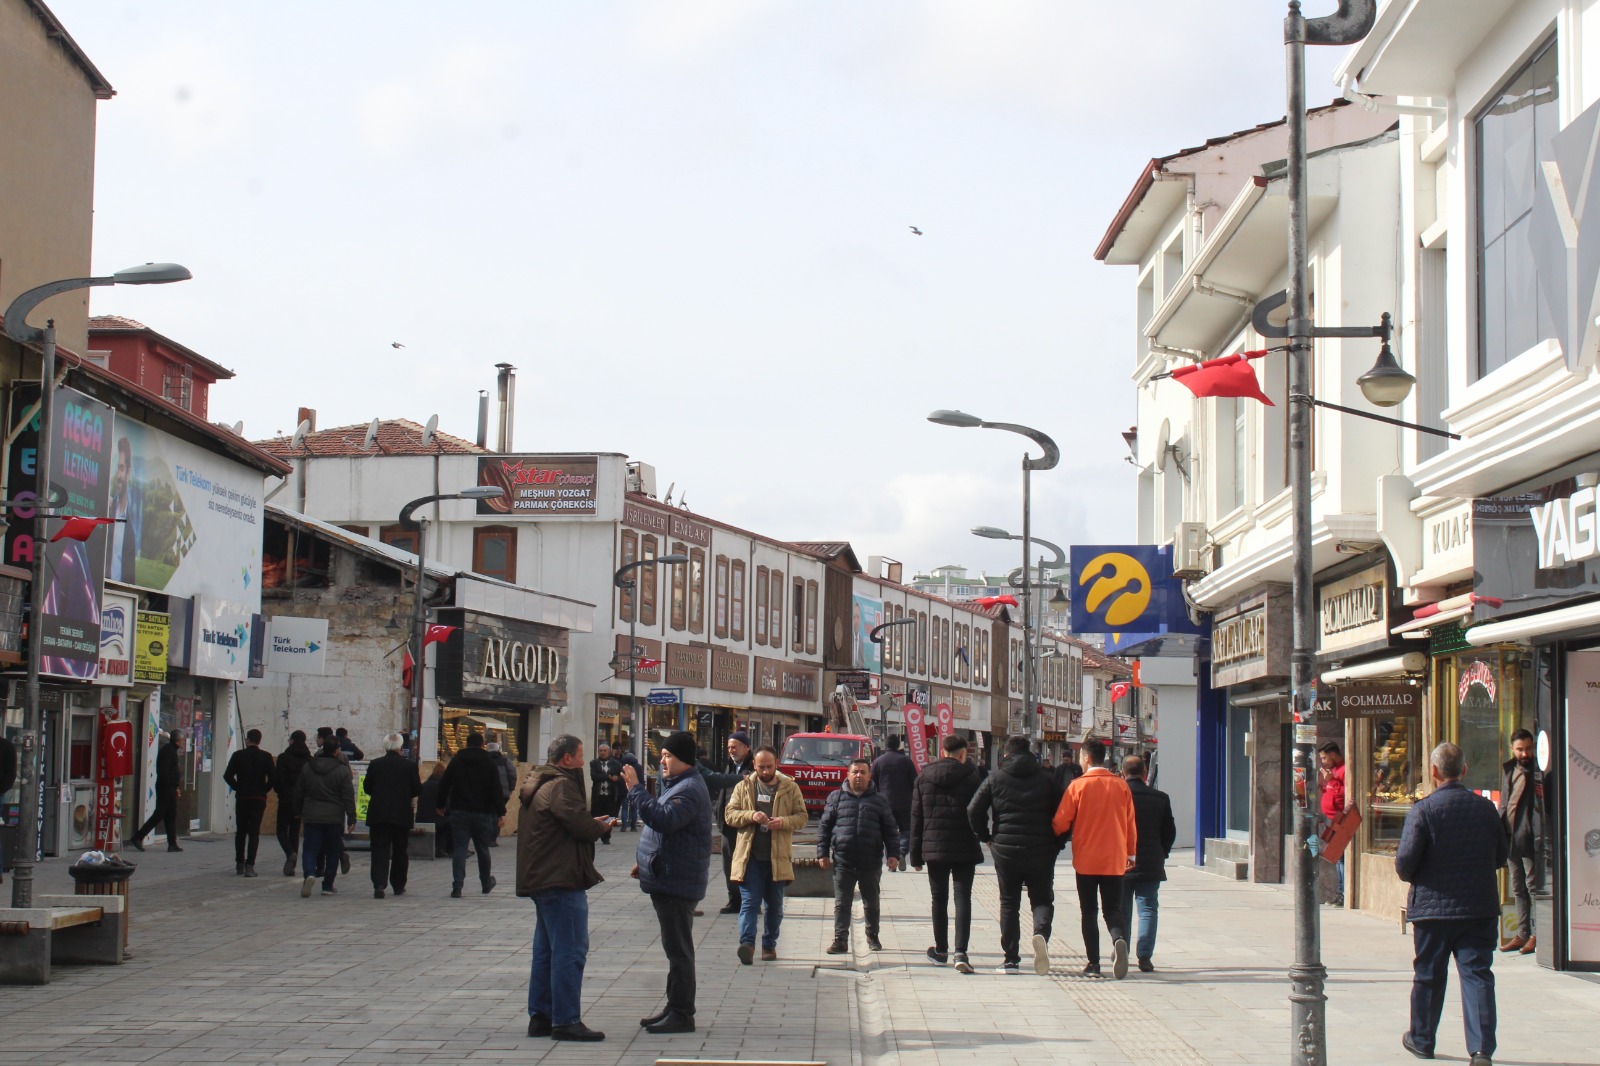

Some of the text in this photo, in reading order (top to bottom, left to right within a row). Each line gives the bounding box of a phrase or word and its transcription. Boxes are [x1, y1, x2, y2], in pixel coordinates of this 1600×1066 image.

[63, 400, 103, 453] REGA
[63, 445, 99, 490] İLETİŞİM
[176, 464, 257, 510] Türk Telekom yüksek çekim gücüyle
[520, 489, 591, 500] MEŞHUR YOZGAT
[514, 500, 549, 509] PARMAK
[674, 520, 707, 542] EMLAK
[1530, 473, 1600, 569] YAĞ
[1325, 584, 1378, 633] SOLMAZLAR
[217, 631, 238, 648] Telekom
[273, 636, 291, 645] Türk
[273, 644, 306, 654] Telekom
[107, 659, 128, 675] AYRAN
[483, 635, 560, 685] AKGOLD
[782, 671, 801, 694] Bizim
[1341, 693, 1413, 707] SOLMAZLAR
[36, 781, 45, 862] SERVİS
[98, 785, 110, 840] DÖNER
